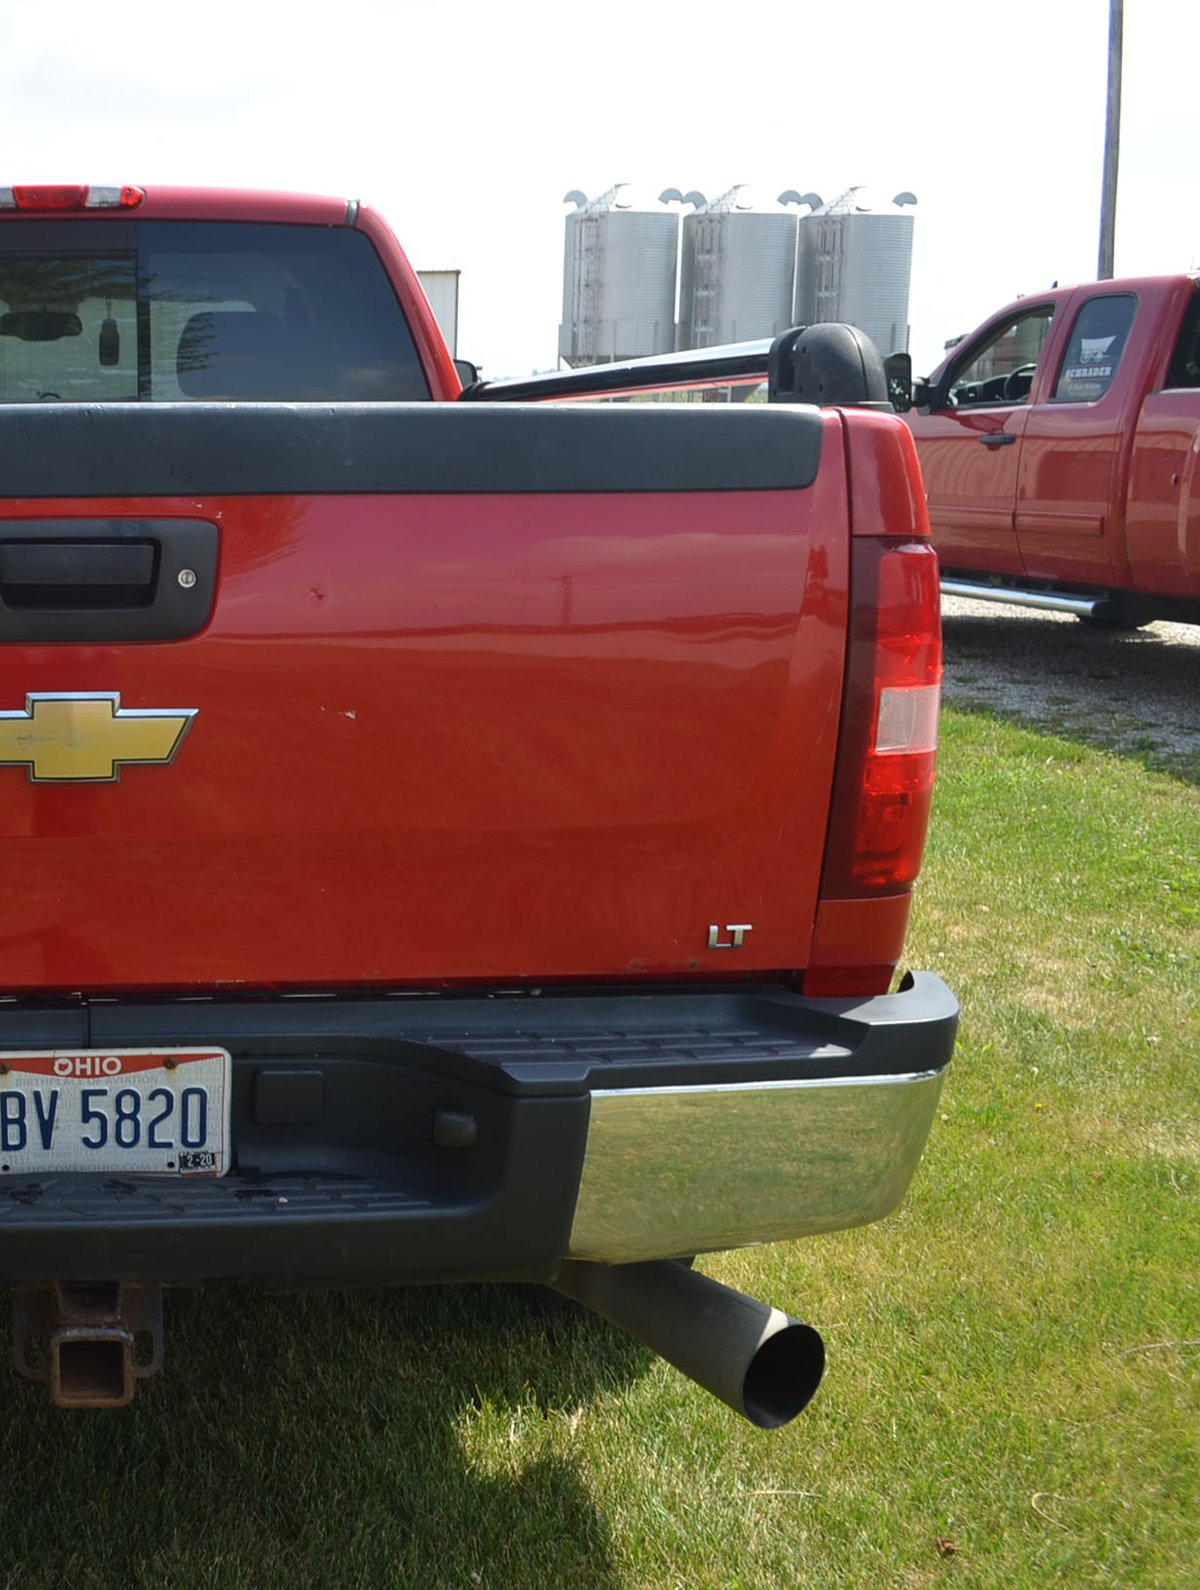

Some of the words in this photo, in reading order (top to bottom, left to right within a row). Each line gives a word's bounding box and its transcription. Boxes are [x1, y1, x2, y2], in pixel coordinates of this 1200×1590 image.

[707, 924, 753, 948] LT
[53, 1056, 122, 1077] OHIO
[15, 1077, 85, 1087] BIRTHPLACE
[105, 1074, 158, 1085] AVIATION
[80, 1086, 208, 1149] 5820
